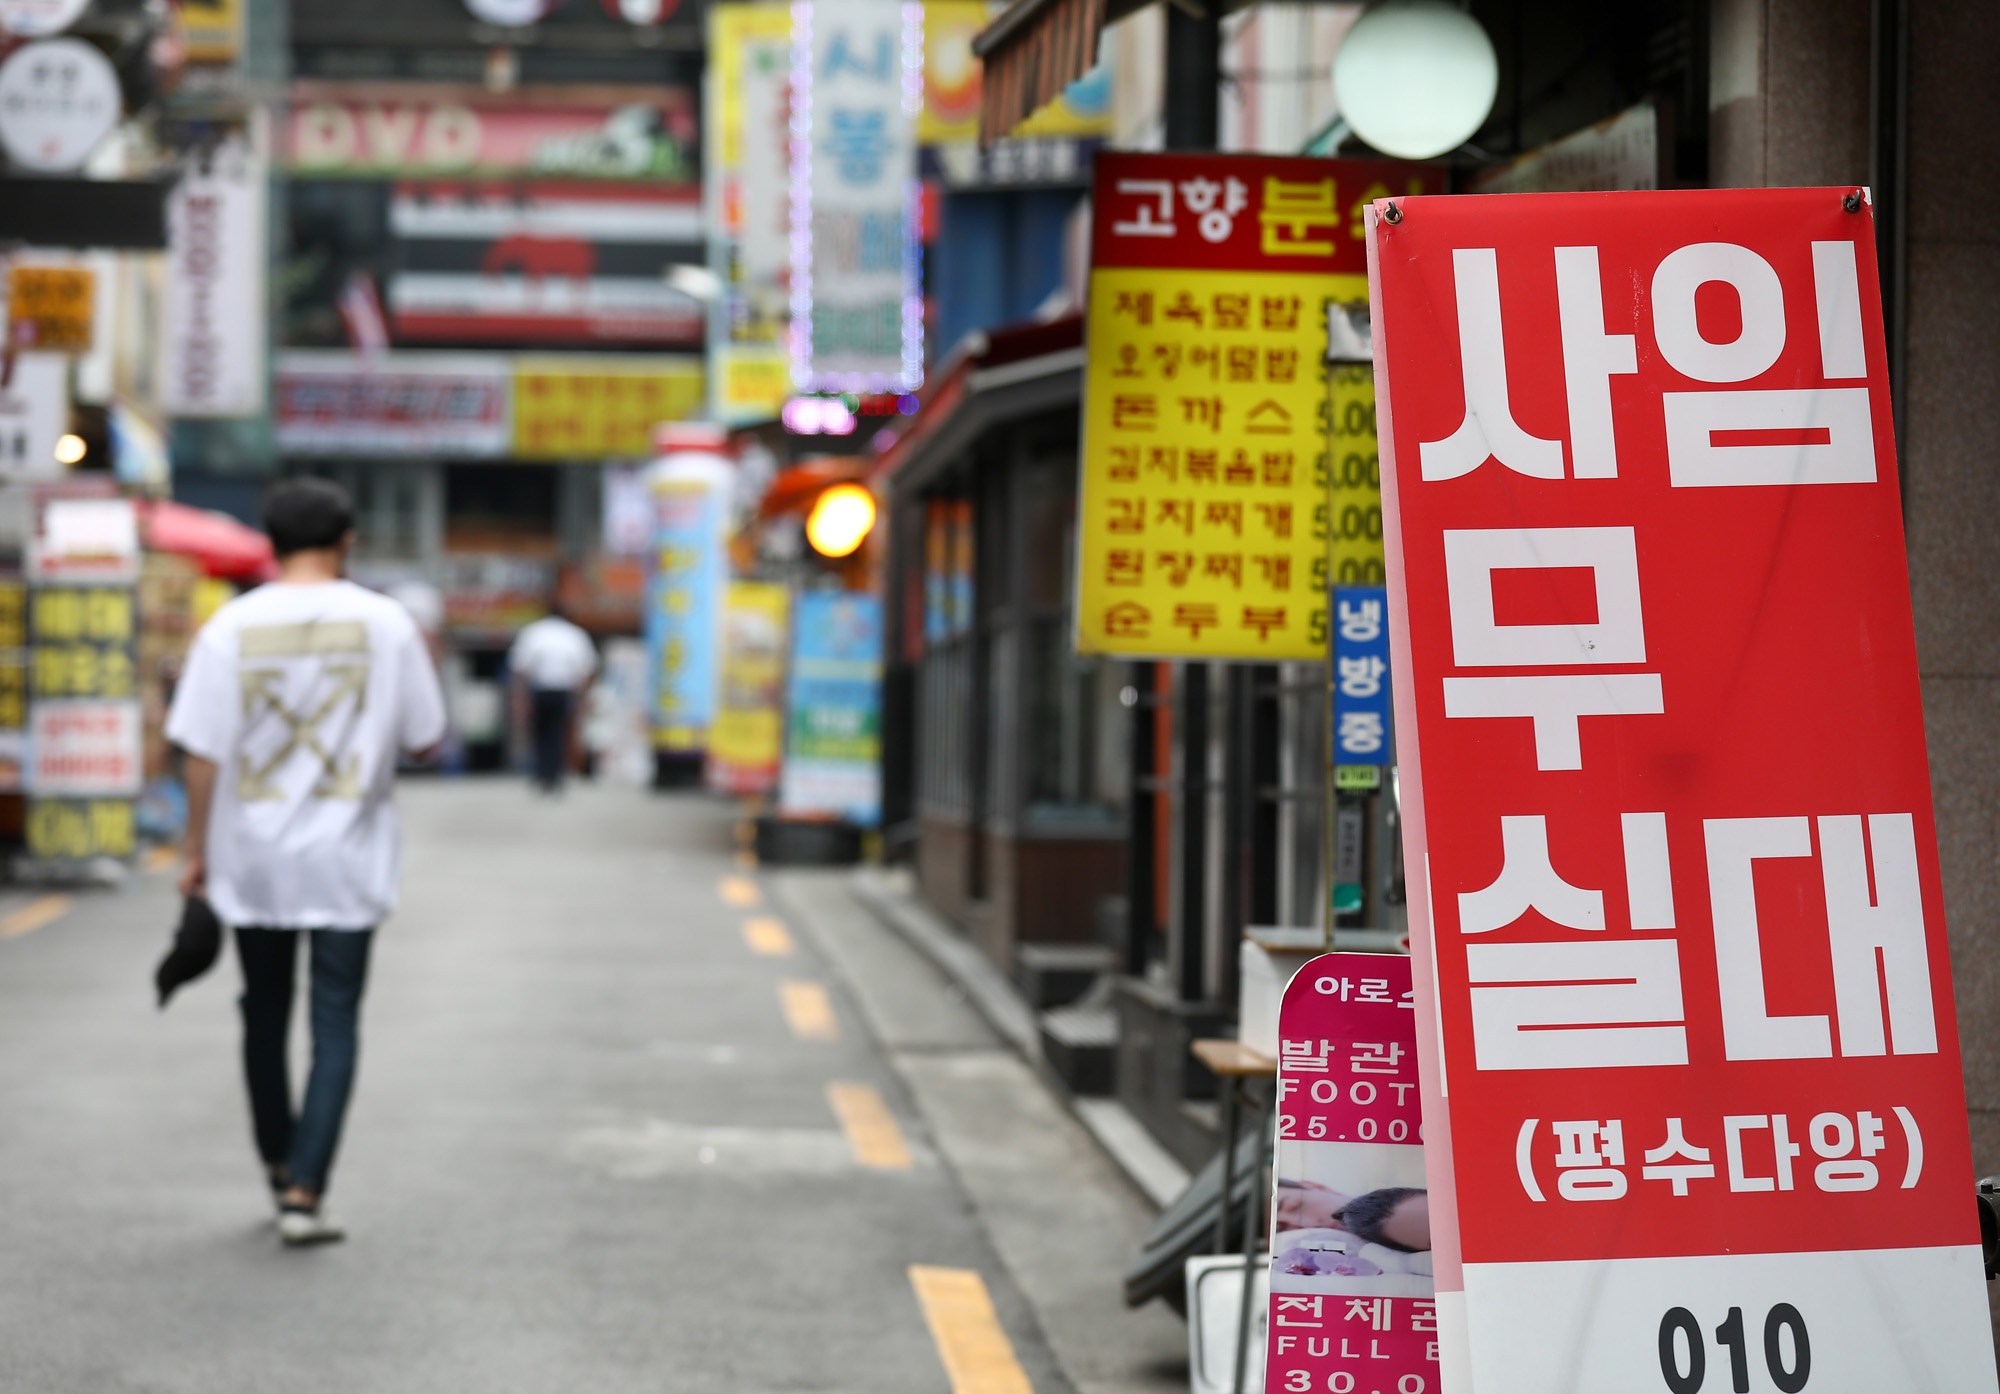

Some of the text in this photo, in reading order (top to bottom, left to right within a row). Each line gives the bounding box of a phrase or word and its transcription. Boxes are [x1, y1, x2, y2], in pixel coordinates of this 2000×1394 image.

[1112, 175, 1249, 244] 고향
[1112, 290, 1302, 331] 제육덮밥
[1110, 343, 1299, 384] 오징어덮밥
[1110, 393, 1294, 436] 돈까스
[1107, 446, 1295, 488] 김치볶음밥
[1106, 497, 1294, 540] 김치찌개
[1104, 548, 1294, 592] 된장찌개
[1103, 599, 1289, 643] 순두부
[1339, 599, 1387, 753] 냉방중
[1279, 1078, 1415, 1107] FOOT
[1279, 1114, 1424, 1141] 25.00
[1515, 1106, 1924, 1202] (평수다양)
[1277, 1335, 1391, 1360] FULL
[1658, 1302, 1811, 1394] 010
